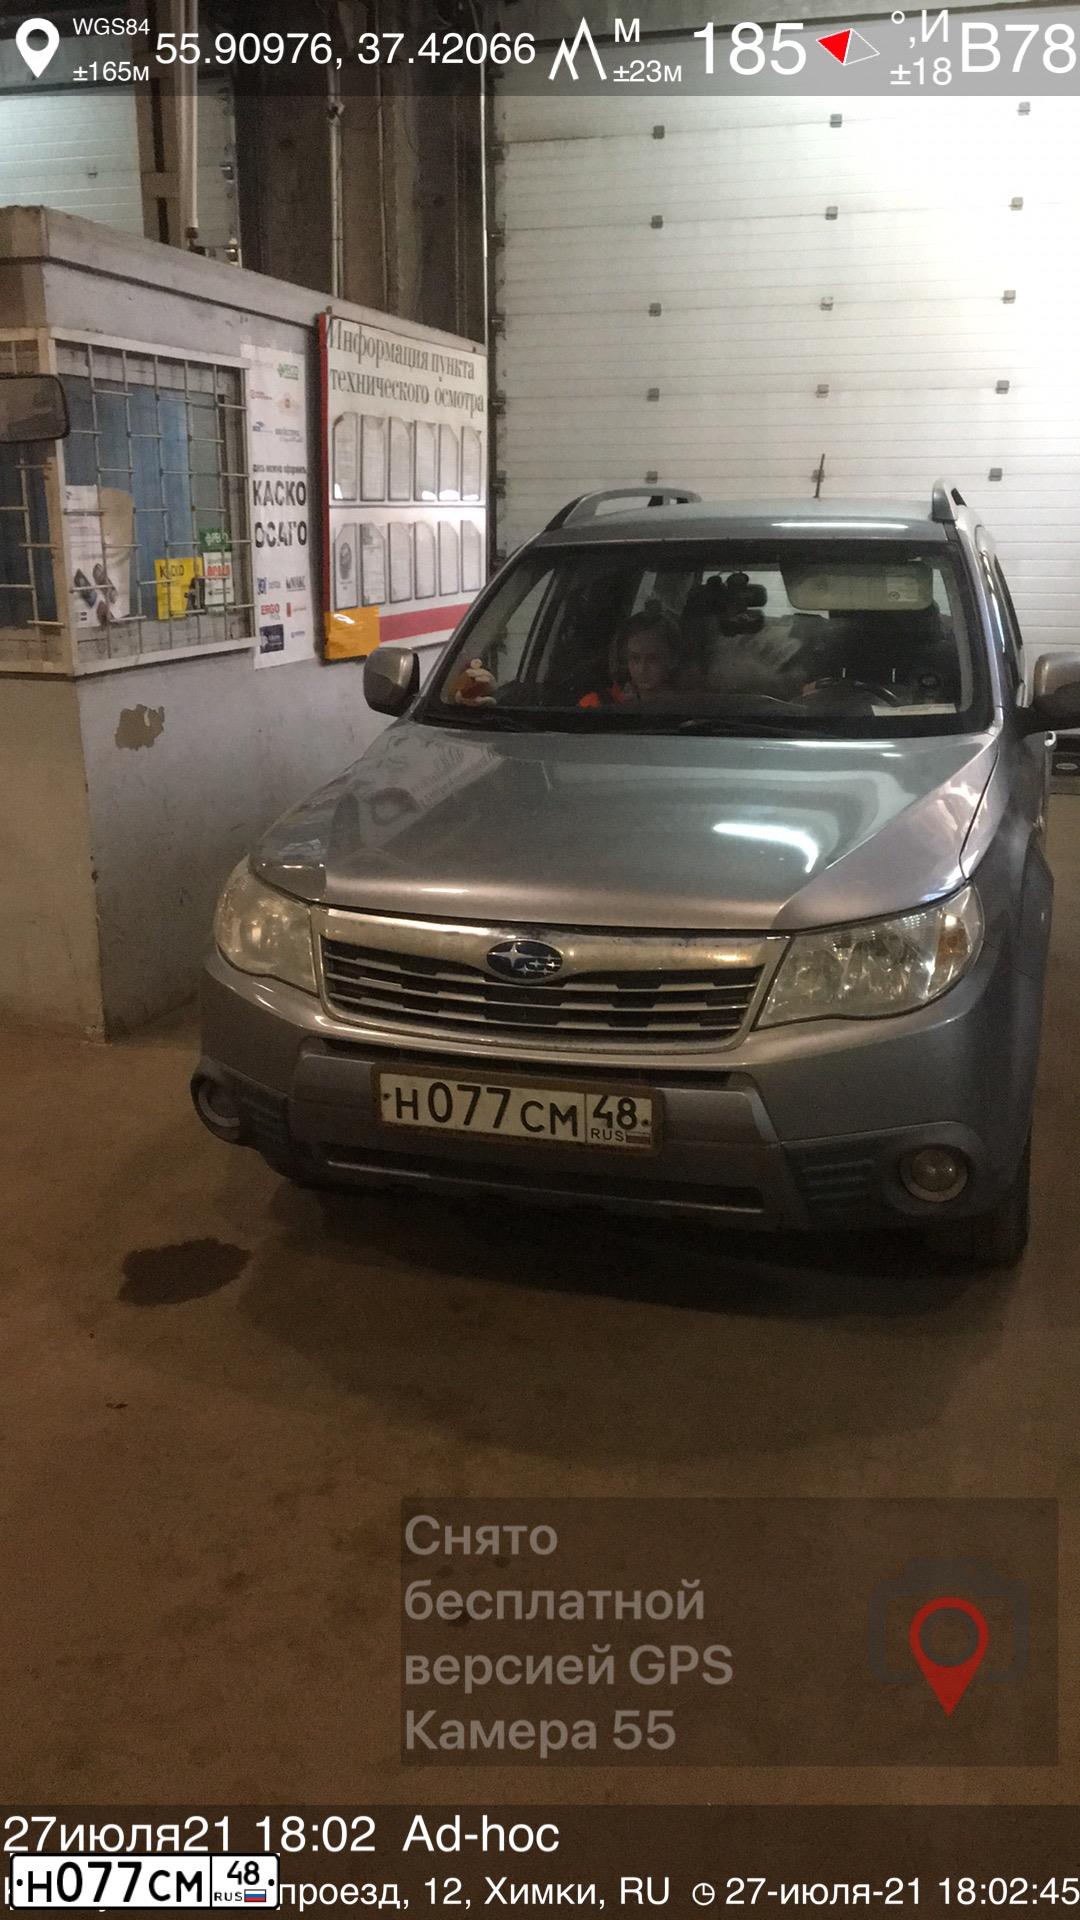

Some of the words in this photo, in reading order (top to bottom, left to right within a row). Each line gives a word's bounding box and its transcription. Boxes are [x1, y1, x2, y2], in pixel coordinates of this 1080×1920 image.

[327, 319, 429, 371] Информация
[432, 353, 475, 381] пункта
[330, 369, 430, 404] технического
[434, 386, 485, 418] осмотра
[253, 480, 307, 506] КАСКО
[254, 521, 307, 548] ОСАГО
[395, 1082, 578, 1137] Н077СМ
[592, 1095, 638, 1131] 48
[591, 1128, 625, 1142] RUS
